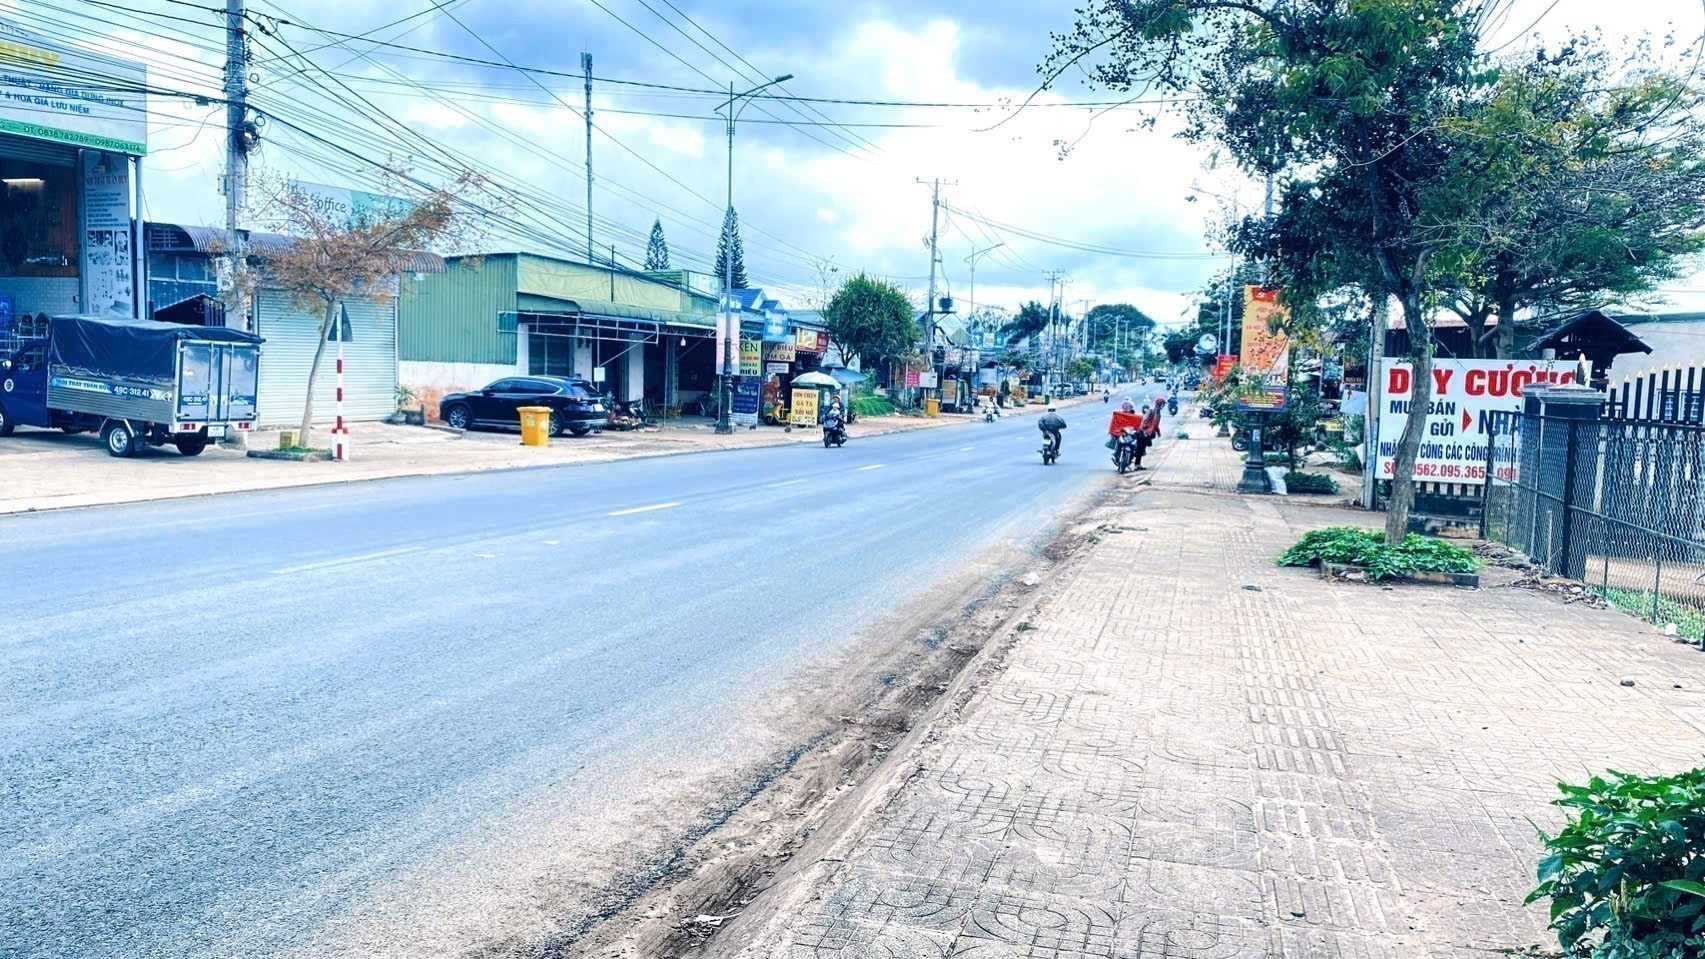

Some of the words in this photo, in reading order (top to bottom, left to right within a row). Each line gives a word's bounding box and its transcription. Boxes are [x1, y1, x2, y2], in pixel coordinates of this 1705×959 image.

[317, 196, 346, 213] office
[1388, 368, 1454, 395] DY
[1390, 400, 1412, 414] MU
[1427, 399, 1456, 415] BÁN
[1430, 419, 1454, 436] GỬI
[1420, 441, 1443, 459] CÔNG
[1445, 441, 1462, 460] CÁC
[1465, 442, 1489, 461] CÔNG
